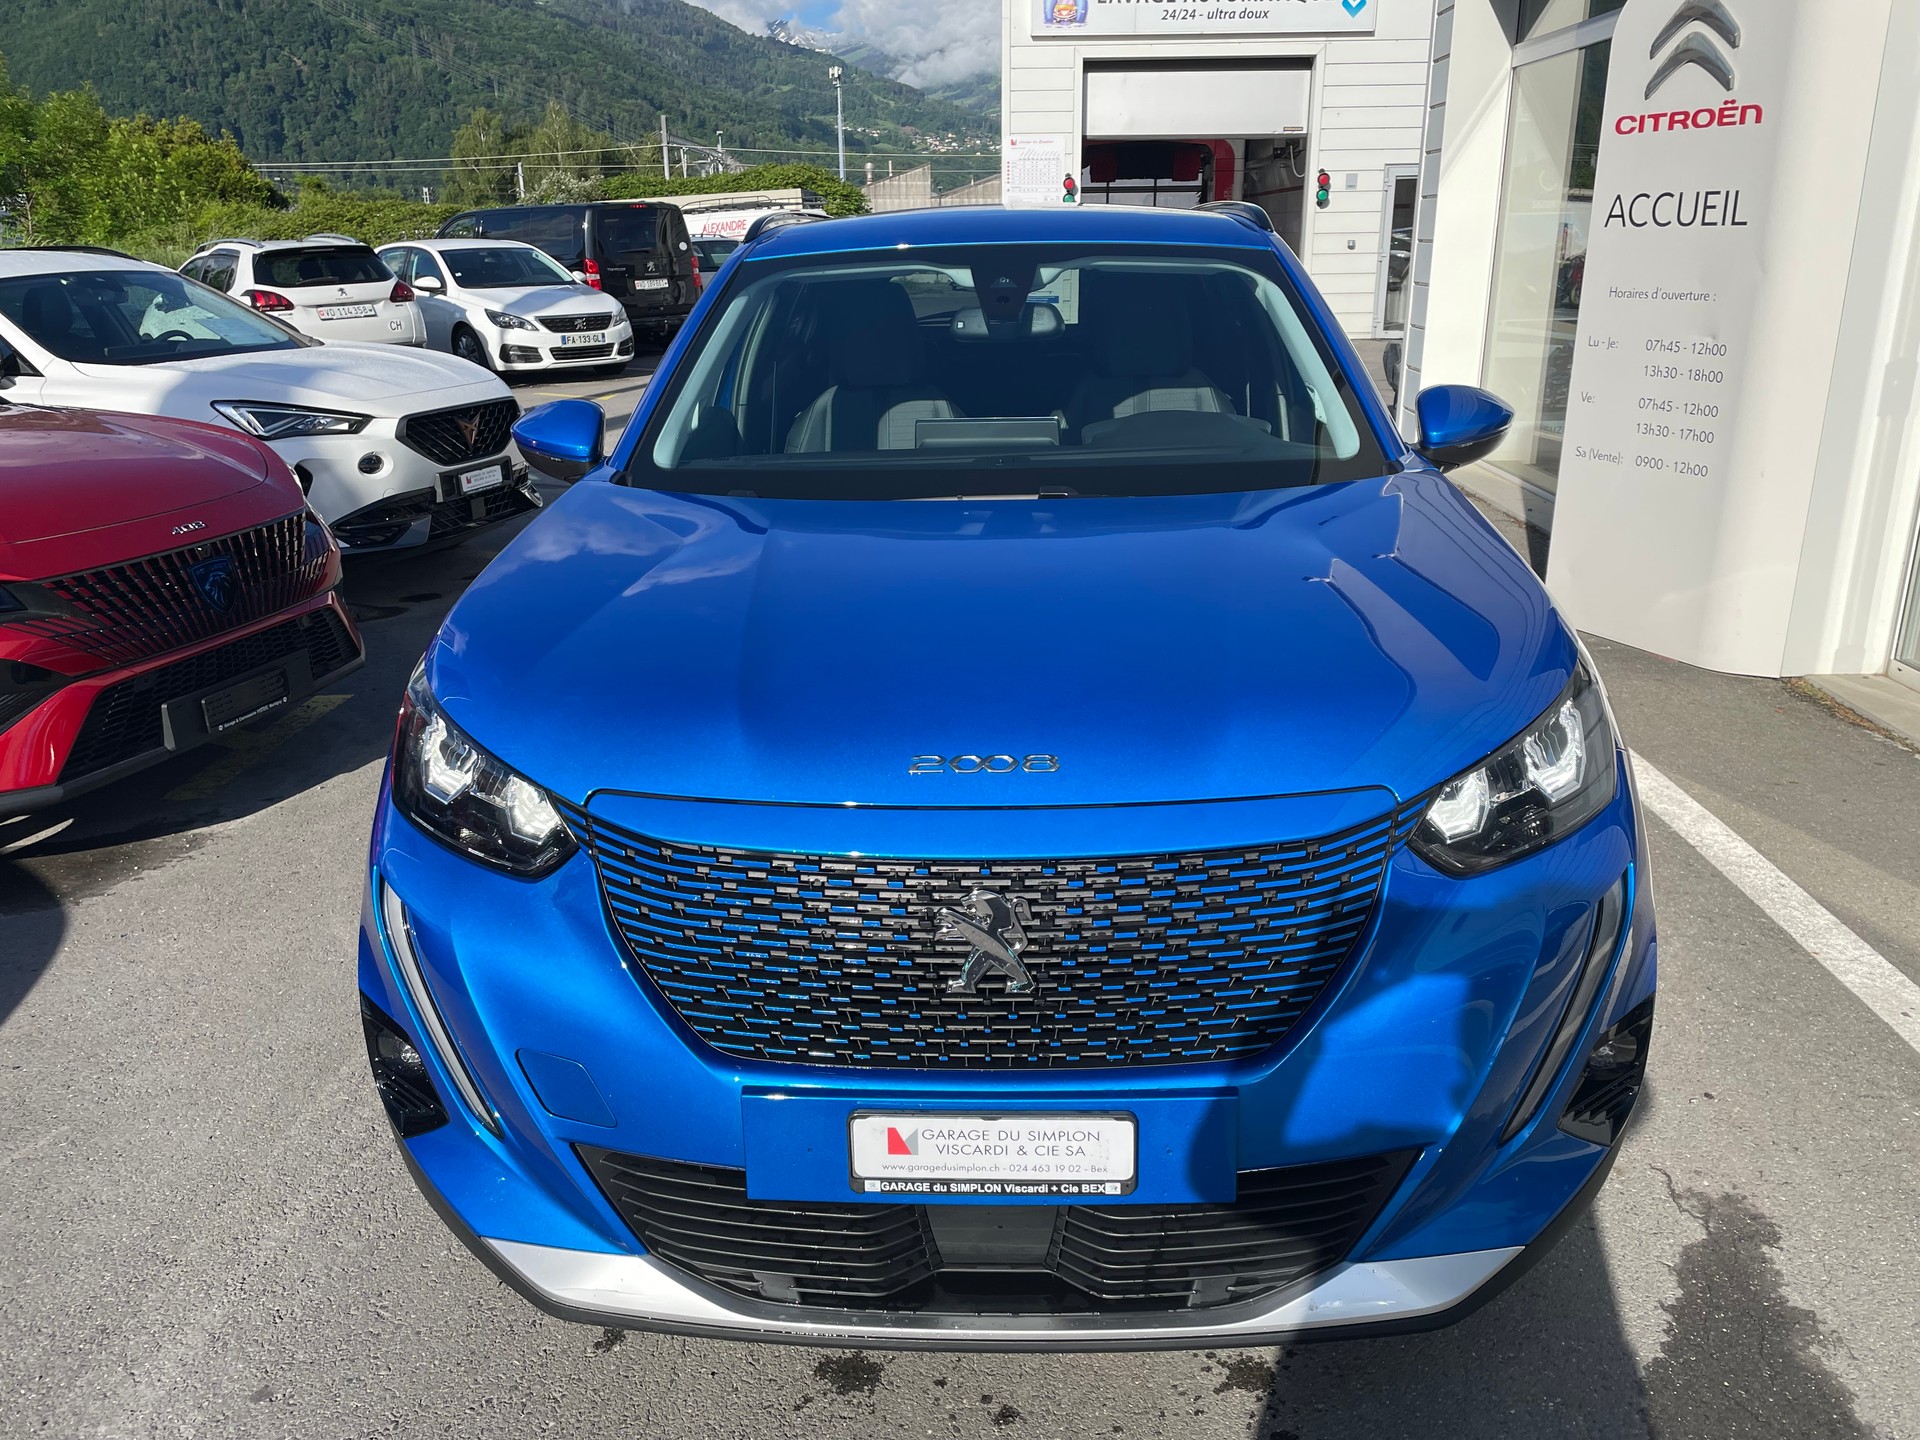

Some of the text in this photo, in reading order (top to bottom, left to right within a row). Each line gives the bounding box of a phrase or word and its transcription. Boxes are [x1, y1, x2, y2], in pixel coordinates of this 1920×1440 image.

[1162, 9, 1196, 20] 24/24
[1207, 8, 1236, 19] ultra
[1239, 7, 1269, 19] doux
[1604, 190, 1748, 228] ACCUEIL
[702, 219, 747, 234] ALEXANDRE
[1609, 287, 1648, 299] Horaires
[325, 305, 368, 317] VD 114358
[389, 320, 403, 331] CH
[1589, 336, 1599, 347] Lu
[1646, 340, 1680, 353] 07h45
[1692, 342, 1727, 356] 12h00
[1645, 365, 1677, 379] 13h30
[1689, 369, 1723, 383] 18h00
[1581, 392, 1595, 403] Ve:
[1639, 398, 1672, 412] 07h45
[1684, 403, 1718, 417] 12h00
[1637, 423, 1669, 437] 13h30
[1680, 429, 1714, 443] 17h00
[1576, 446, 1586, 457] Sa
[1636, 456, 1663, 470] 0900
[1674, 462, 1708, 477] 12h00
[908, 754, 1061, 775] 2008
[922, 1129, 1099, 1141] GARAGE DU SIMPLON
[936, 1144, 1085, 1156] VISCARDI & CIE SA
[882, 1163, 999, 1173] www.garagedusimplon.ch
[1009, 1164, 1027, 1172] 024
[881, 1181, 932, 1192] GARAGE
[933, 1181, 948, 1192] du
[950, 1182, 1003, 1193] SIMPLON
[1004, 1182, 1048, 1193] Viscardi
[1050, 1184, 1059, 1193] +
[1082, 1184, 1107, 1194] BEX
